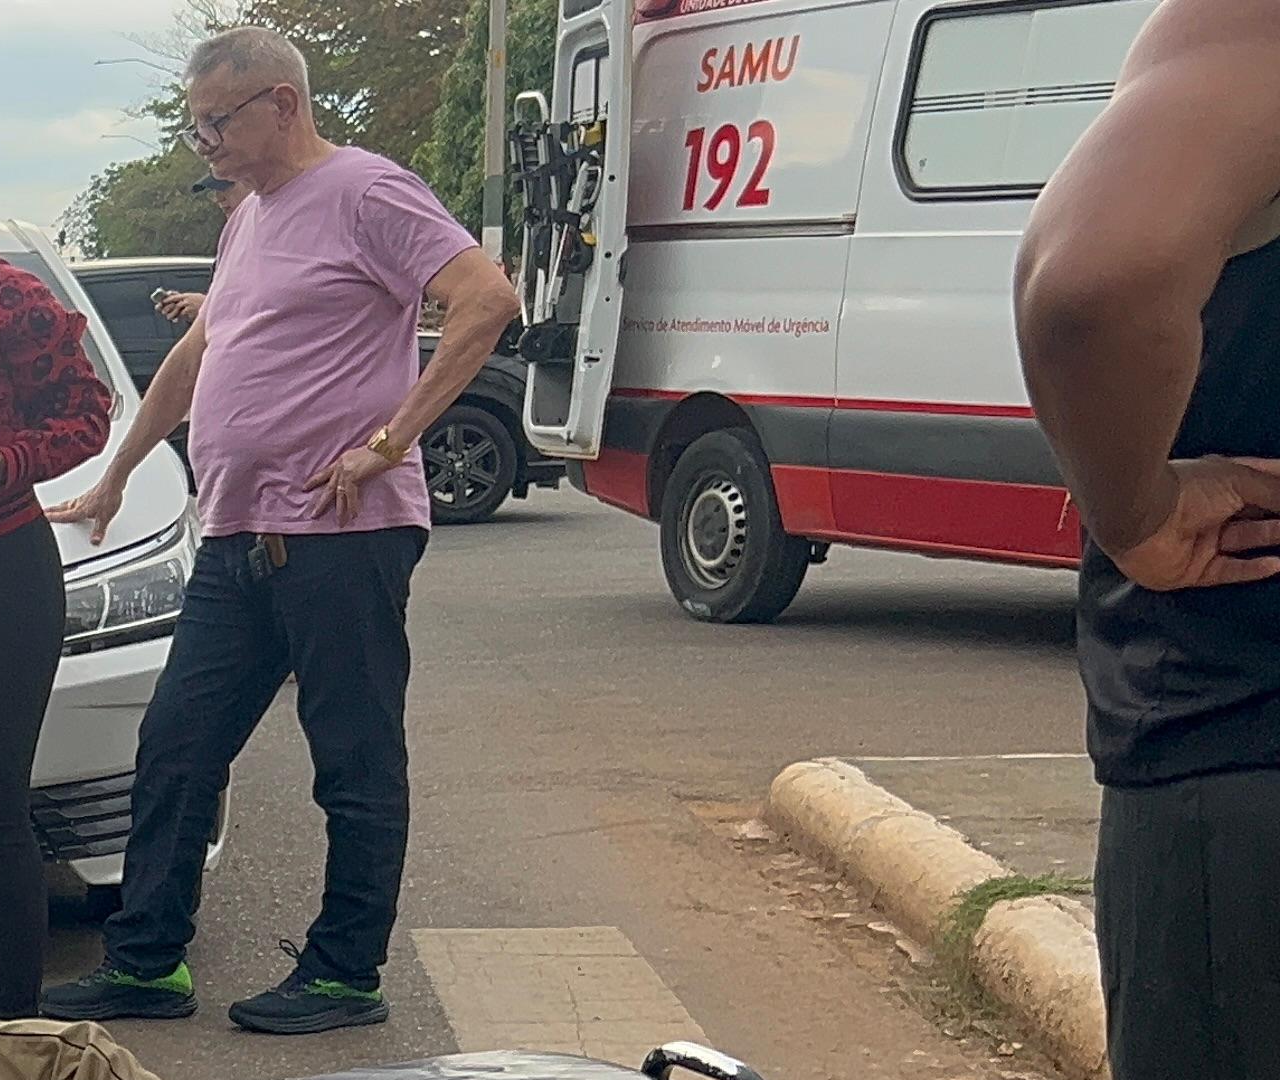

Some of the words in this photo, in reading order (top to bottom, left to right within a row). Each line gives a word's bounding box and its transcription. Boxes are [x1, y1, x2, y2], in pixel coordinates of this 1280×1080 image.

[696, 34, 801, 94] SAMU
[682, 120, 775, 211] 192
[670, 317, 731, 333] Atendimento
[767, 317, 781, 333] de
